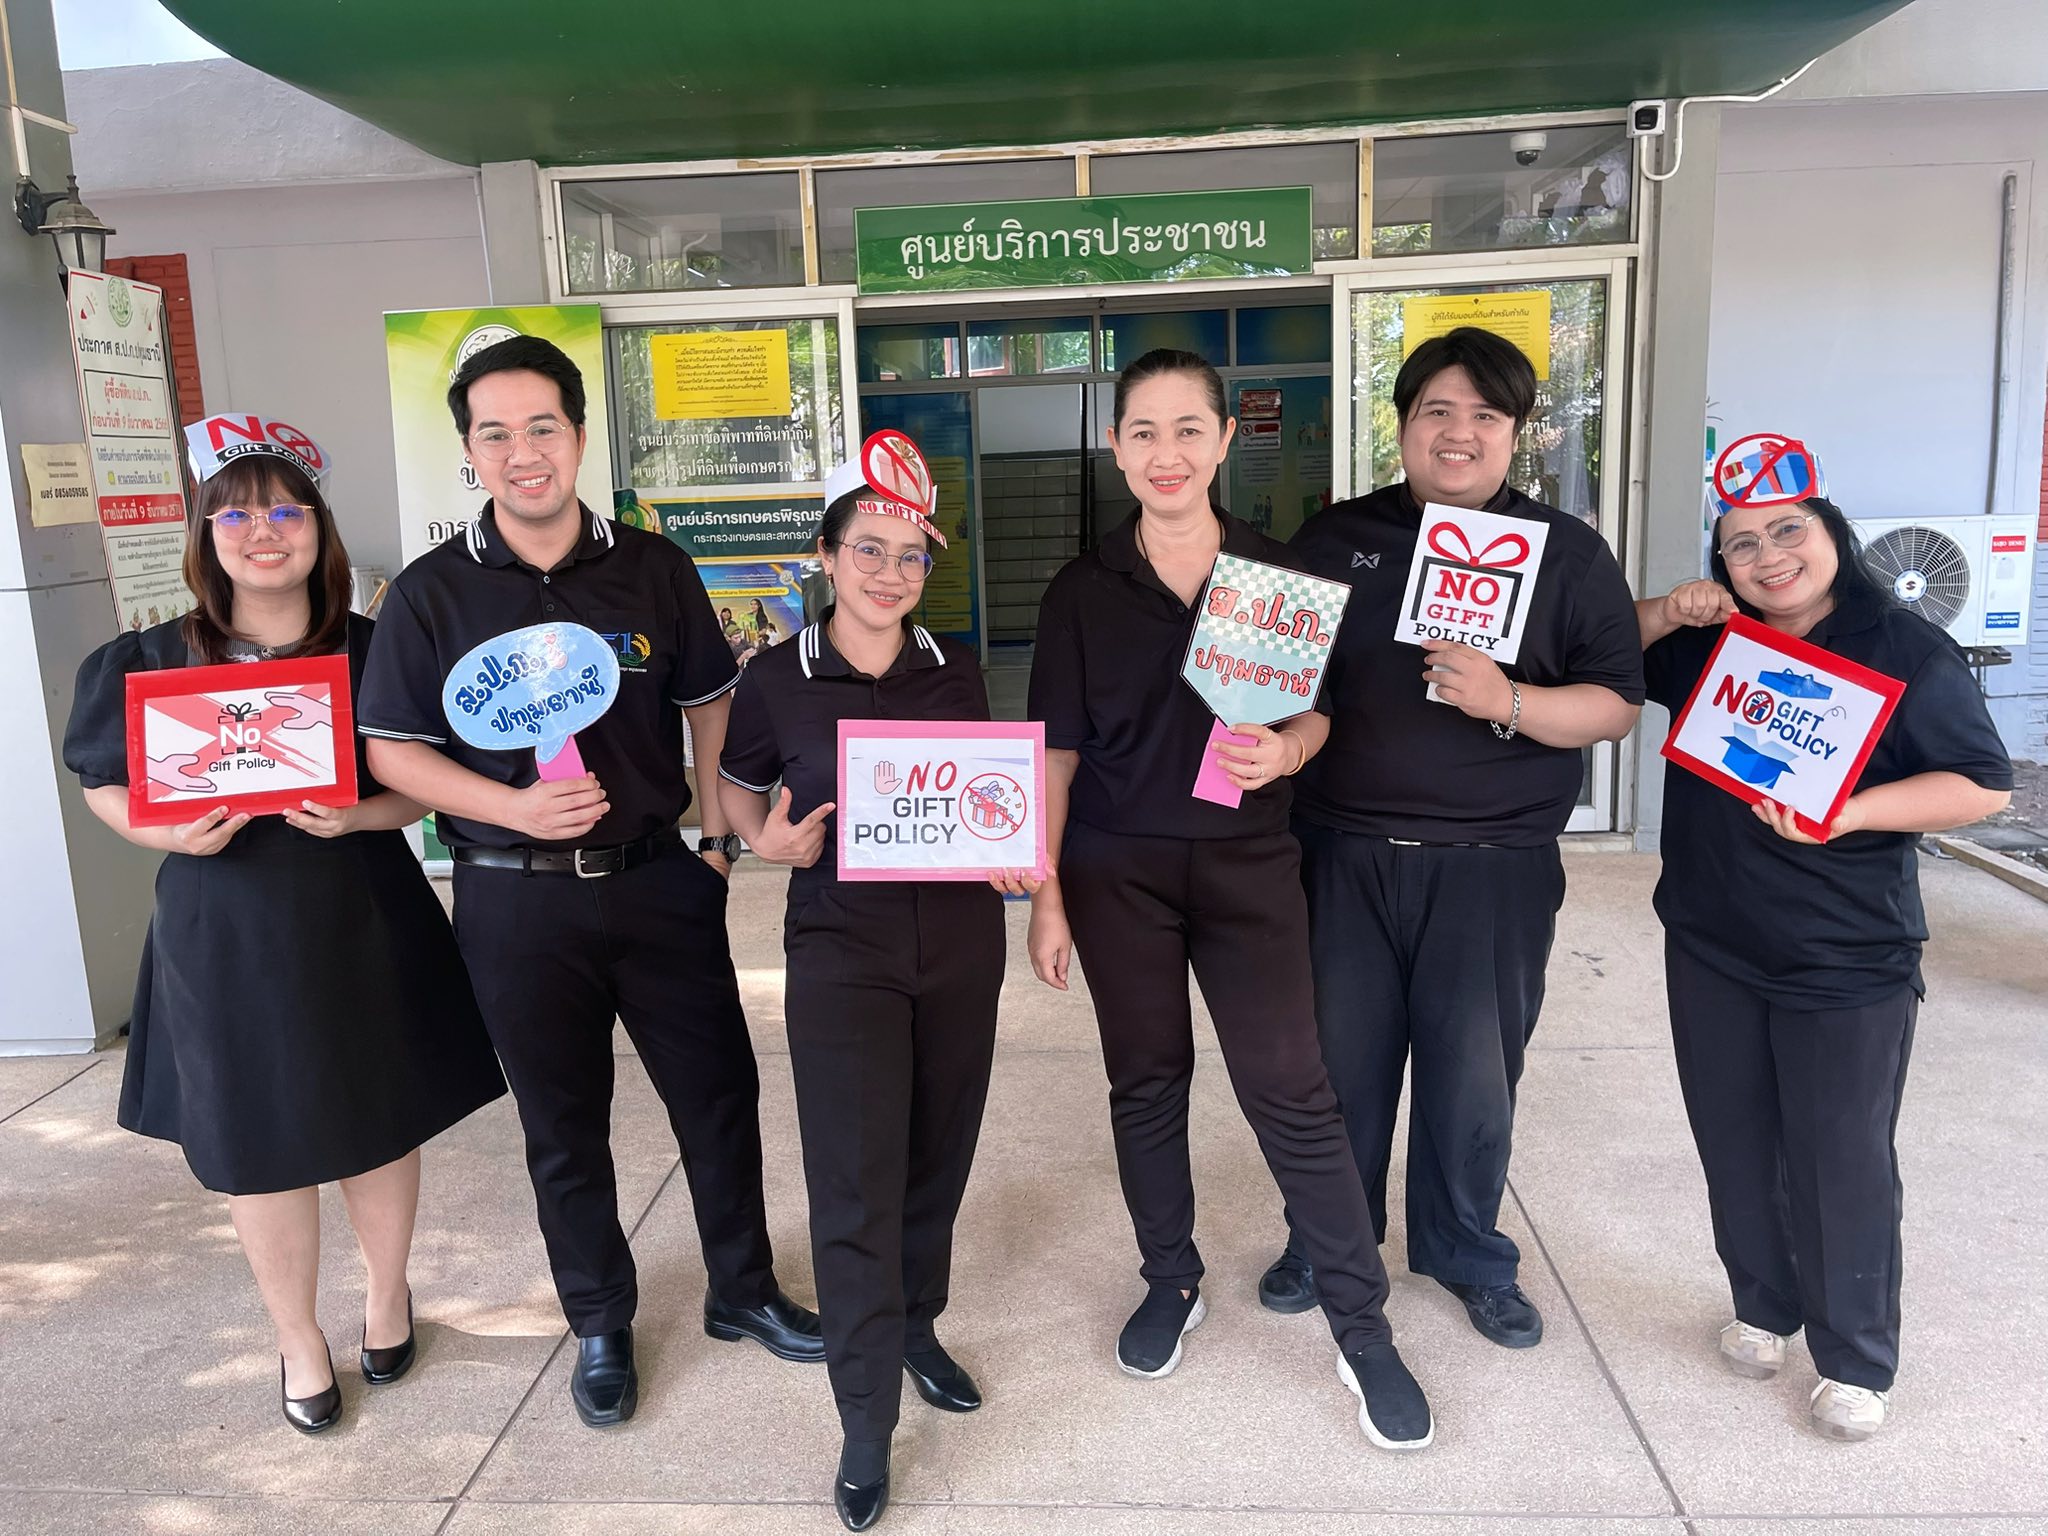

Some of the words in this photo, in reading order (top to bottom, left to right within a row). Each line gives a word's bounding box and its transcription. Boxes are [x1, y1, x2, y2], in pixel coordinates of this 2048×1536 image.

[901, 217, 1266, 281] ศูนย์บริการประชาชน
[77, 333, 113, 355] ประกาศ
[224, 443, 263, 458] Gift
[271, 446, 318, 482] Policy
[139, 505, 145, 518] 9
[667, 508, 826, 532] ศูนย์บริการเกษตรพิรุณร
[857, 501, 878, 513] NO
[883, 501, 912, 520] GIFT
[693, 528, 812, 544] กระทรวงเกษตรและสหกรณ์
[1434, 569, 1500, 606] NO
[1208, 586, 1330, 646] ส.ป.ก.
[1427, 603, 1494, 629] GIFT
[1413, 622, 1500, 650] POLICY
[455, 651, 548, 716] ส.ป.ก.
[1195, 645, 1318, 697] ปทุมธานี
[490, 664, 605, 734] ปทุมธานี
[1776, 700, 1825, 732] GIFT
[220, 723, 261, 747] No
[1766, 717, 1839, 761] POLICY
[208, 759, 231, 773] Gift
[237, 758, 276, 771] Policy
[906, 761, 957, 795] NO
[893, 797, 956, 818] GIFT
[855, 823, 958, 844] POLICY
